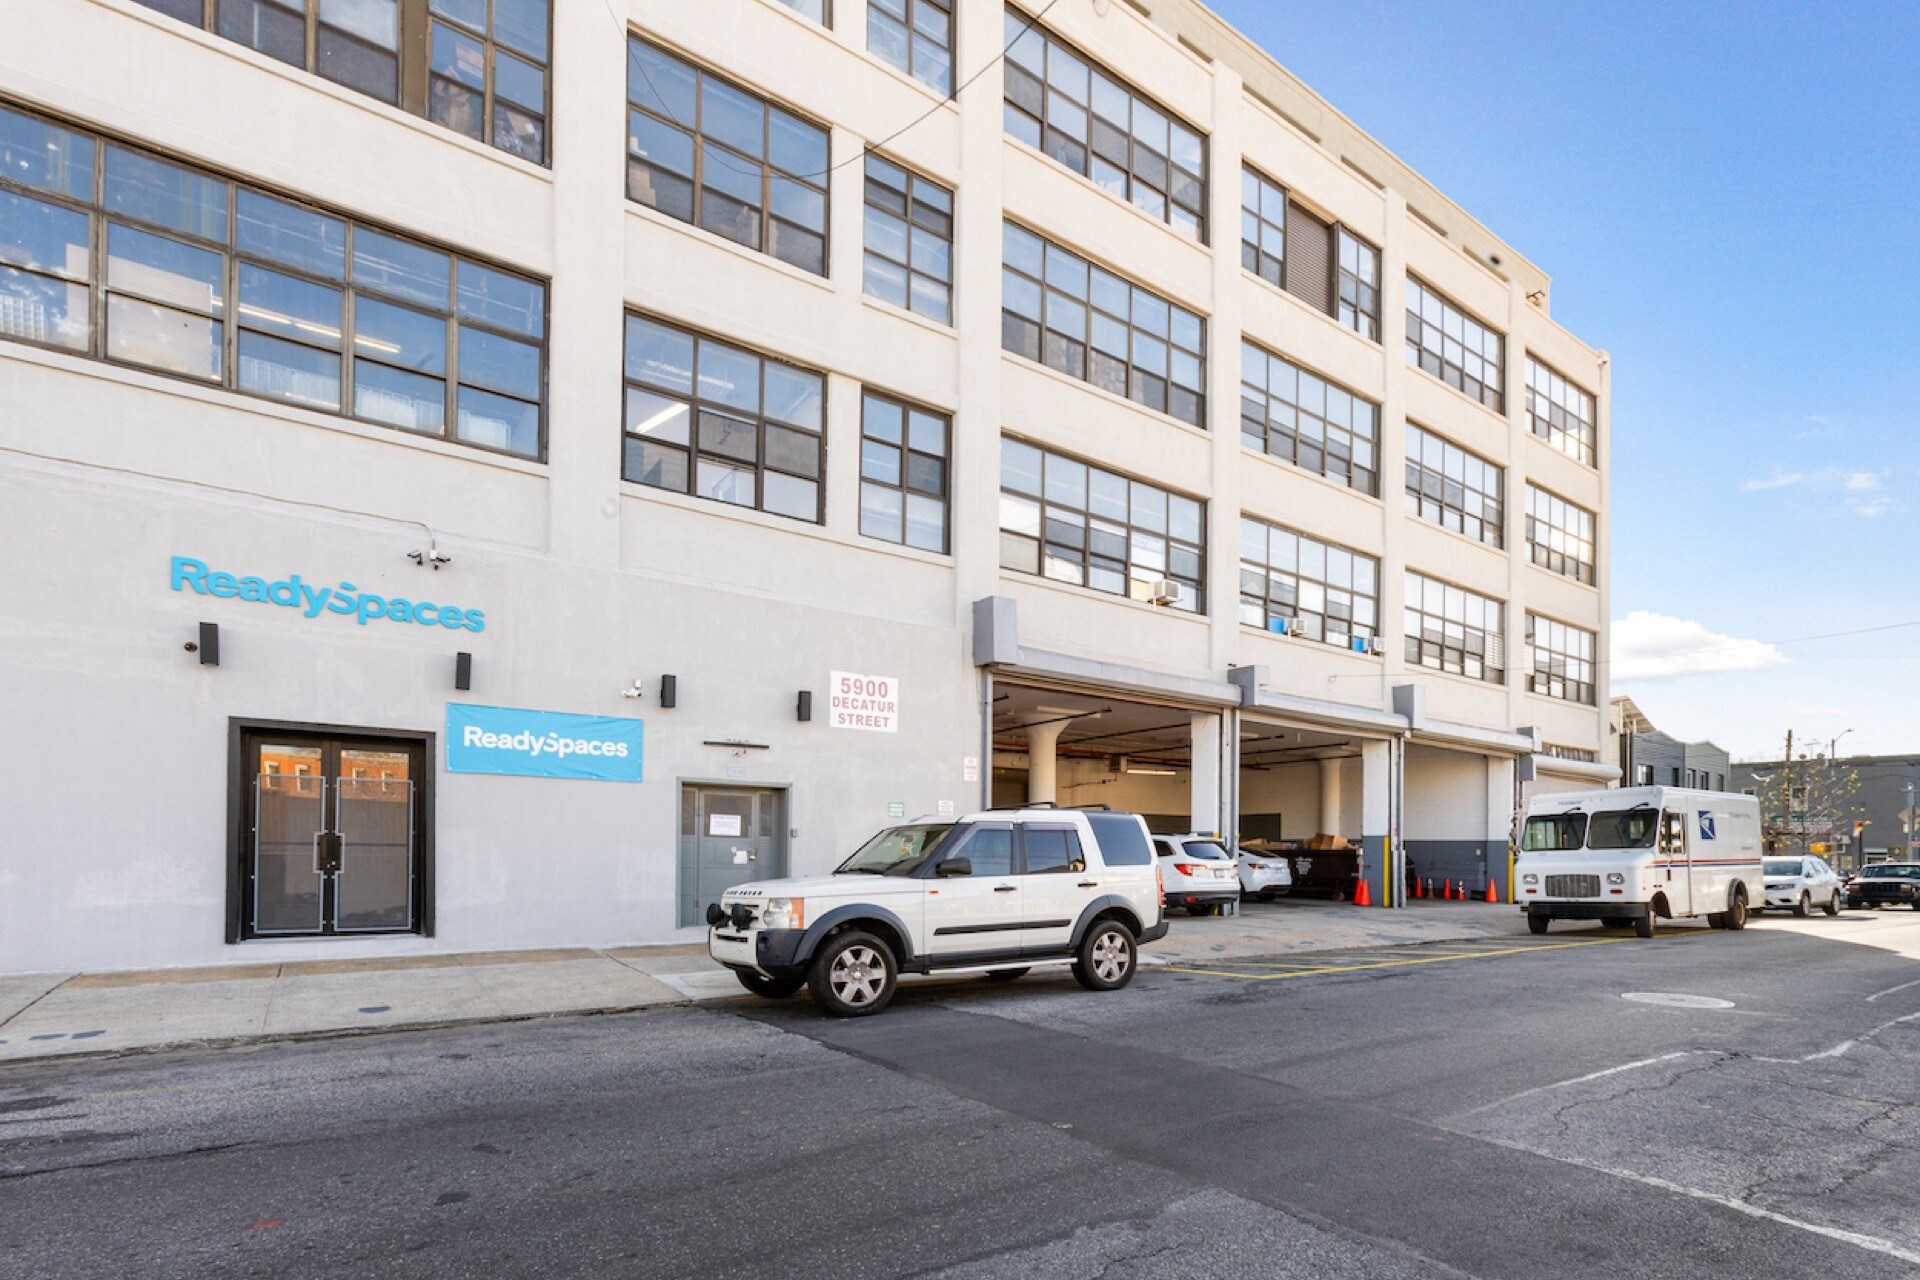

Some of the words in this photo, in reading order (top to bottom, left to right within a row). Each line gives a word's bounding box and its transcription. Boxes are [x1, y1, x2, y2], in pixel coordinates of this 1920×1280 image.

[170, 555, 486, 632] ReadySpaces
[840, 677, 888, 698] 5900
[832, 695, 896, 713] DECATUR
[837, 712, 891, 728] STREET
[463, 725, 629, 758] ReadySpaces
